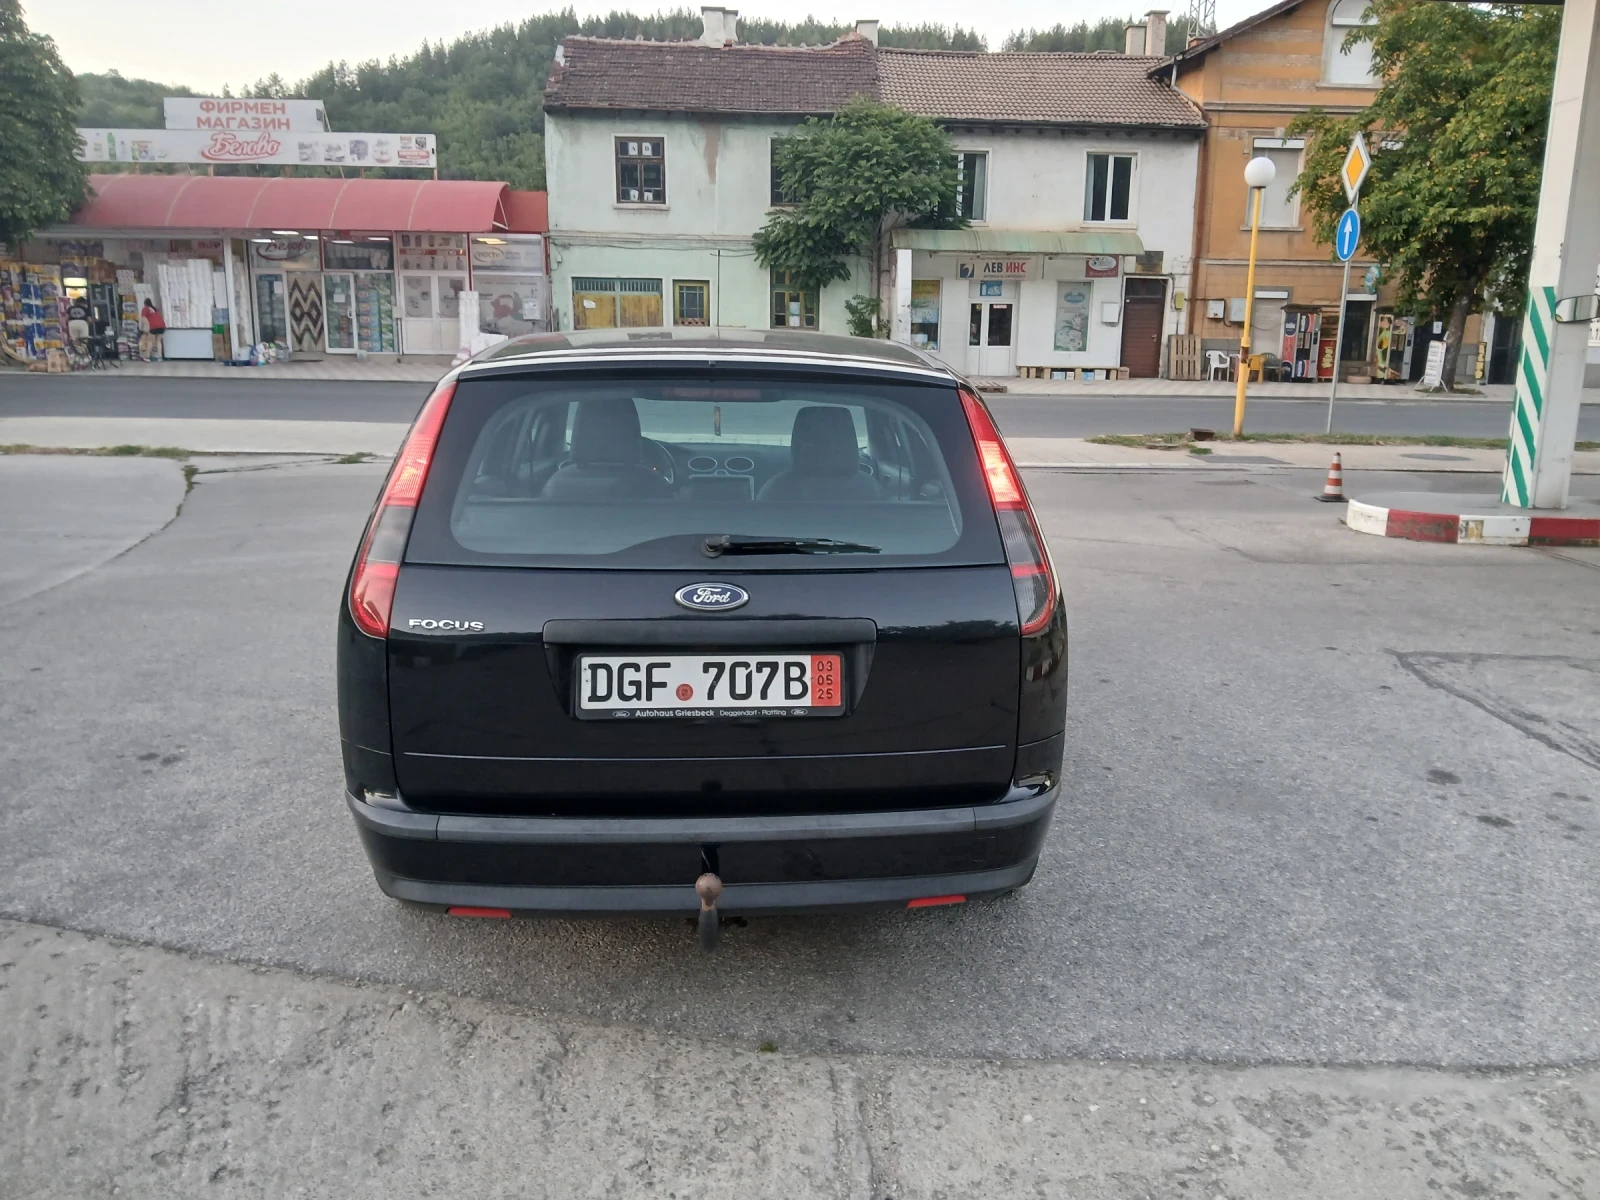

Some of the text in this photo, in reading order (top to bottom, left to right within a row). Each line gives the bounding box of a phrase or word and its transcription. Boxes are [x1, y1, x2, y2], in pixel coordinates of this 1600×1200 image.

[199, 101, 286, 115] ФИРМЕН
[196, 117, 291, 130] МАГАЗИН
[208, 132, 281, 156] Белово
[983, 262, 1026, 273] ЛЕВ ИНС
[693, 587, 731, 603] Ford
[408, 618, 484, 631] FOCUS
[816, 661, 833, 672] 03
[587, 661, 809, 702] DGF 707B
[817, 674, 833, 685] 05
[817, 688, 833, 699] 25
[635, 709, 674, 717] Autohaus
[675, 709, 715, 717] Griesbeck
